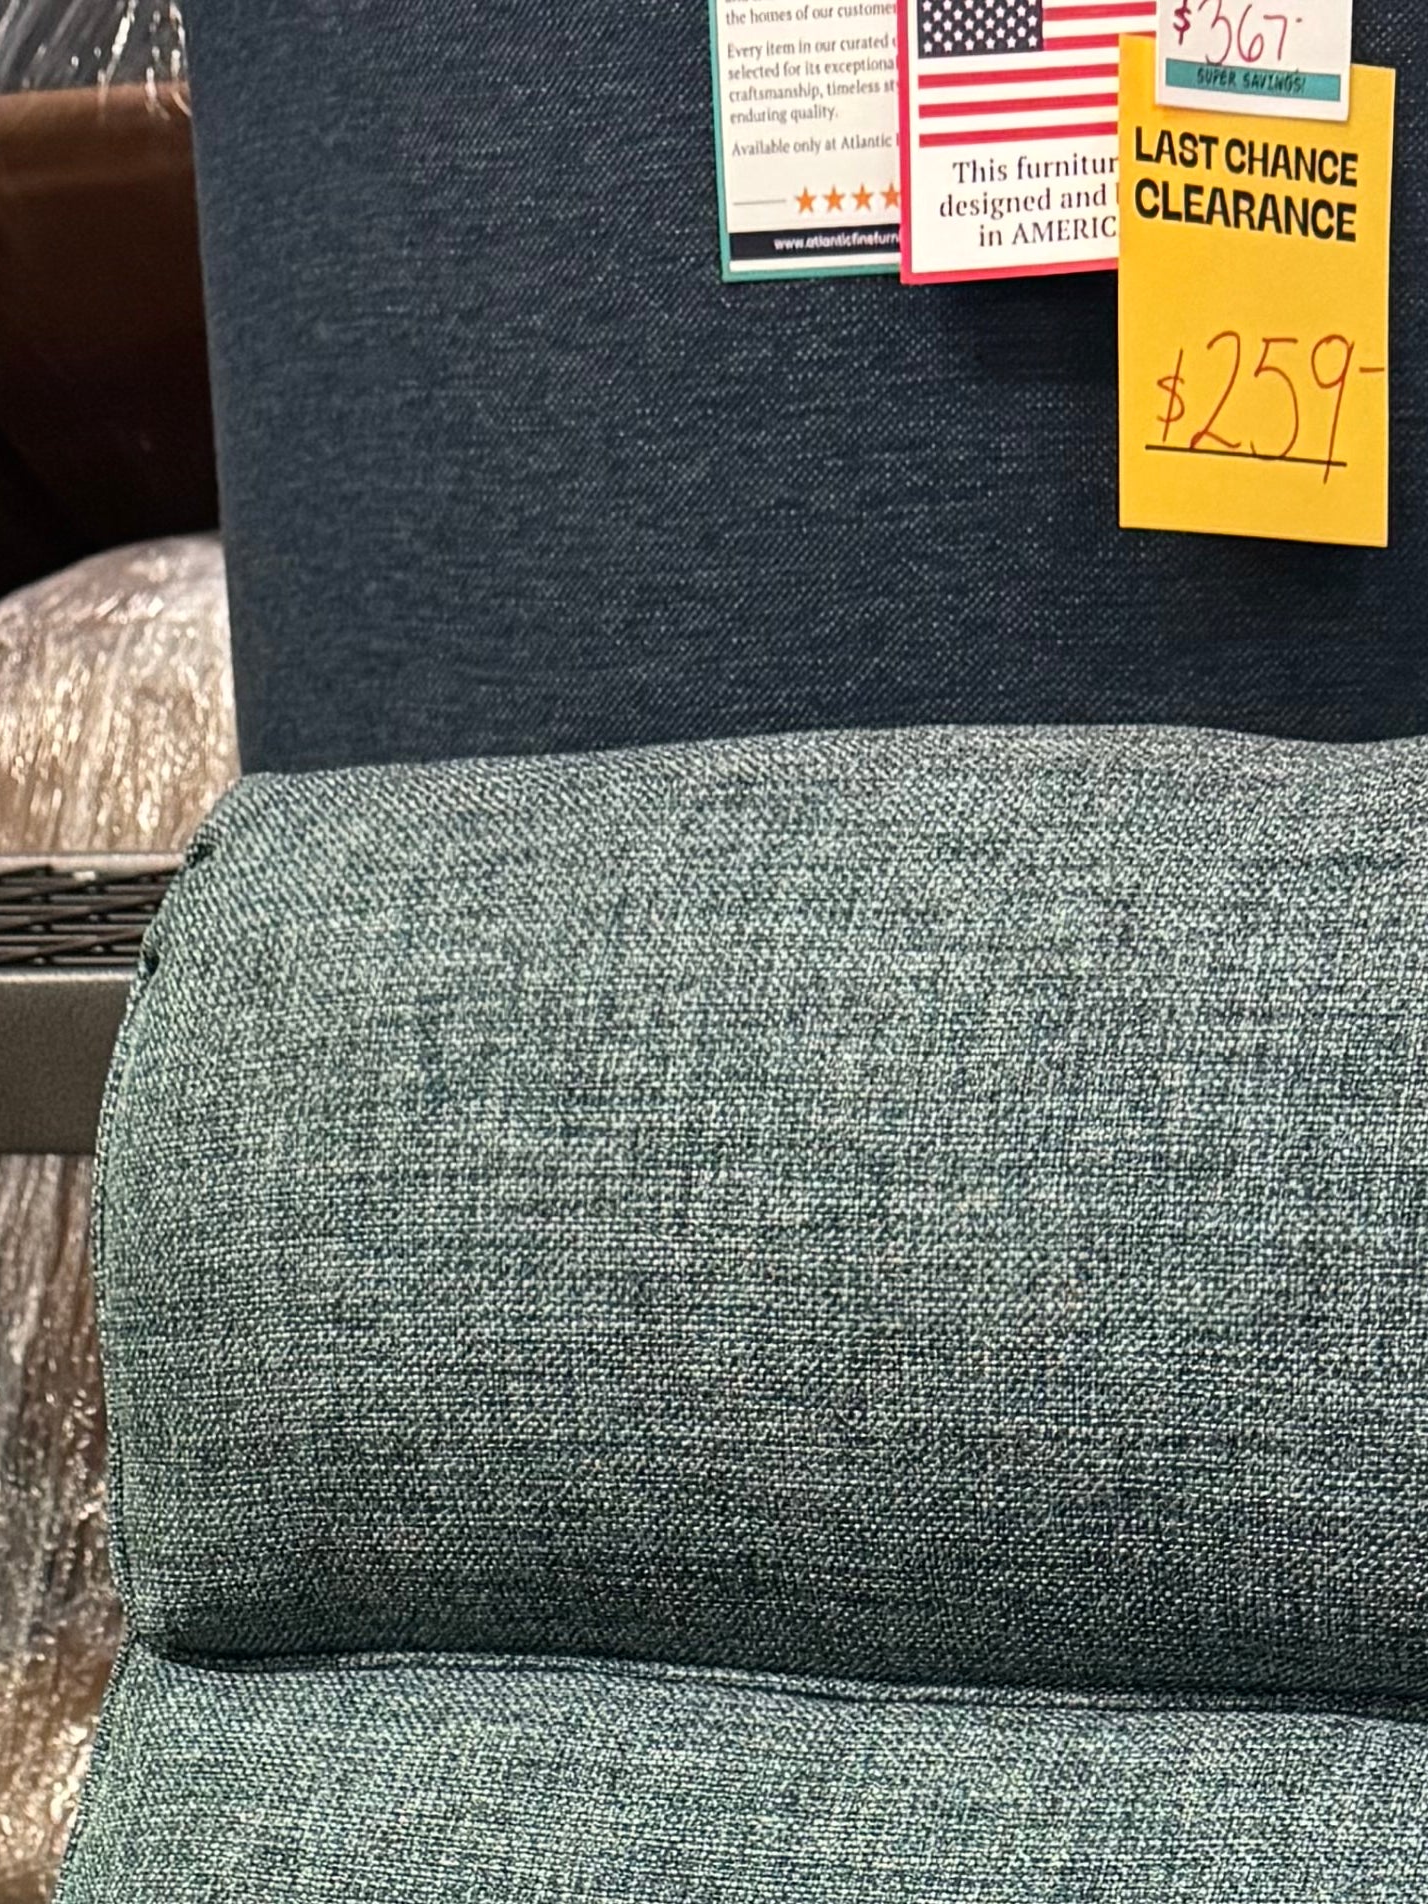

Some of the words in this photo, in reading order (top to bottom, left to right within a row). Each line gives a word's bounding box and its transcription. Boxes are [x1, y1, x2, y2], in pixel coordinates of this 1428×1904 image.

[726, 8, 747, 25] the
[750, 7, 792, 24] homes
[795, 5, 810, 21] of
[812, 7, 834, 21] our
[727, 43, 762, 60] Every
[766, 39, 795, 56] item
[798, 38, 812, 54] in
[815, 40, 836, 54] our
[840, 34, 889, 51] curated
[728, 64, 780, 80] selected
[783, 61, 802, 76] for
[805, 60, 821, 76] its
[824, 57, 896, 75] exceptiona
[1196, 67, 1237, 86] SUPER
[729, 83, 824, 103] craftsmanship,
[827, 79, 881, 97] timeless
[730, 107, 787, 125] enduring
[790, 104, 839, 122] quality.
[732, 138, 790, 157] Available
[793, 136, 822, 156] only
[824, 137, 837, 151] at
[841, 133, 892, 150] Atlantic
[1134, 126, 1219, 170] LAST
[1224, 137, 1359, 188] CHANCE
[952, 158, 1008, 184] This
[1017, 152, 1119, 181] furnitur
[939, 187, 1052, 221] designed
[1060, 183, 1107, 210] and
[1134, 178, 1357, 243] CLEARANCE
[978, 224, 1003, 247] in
[1012, 215, 1118, 246] AMERIC
